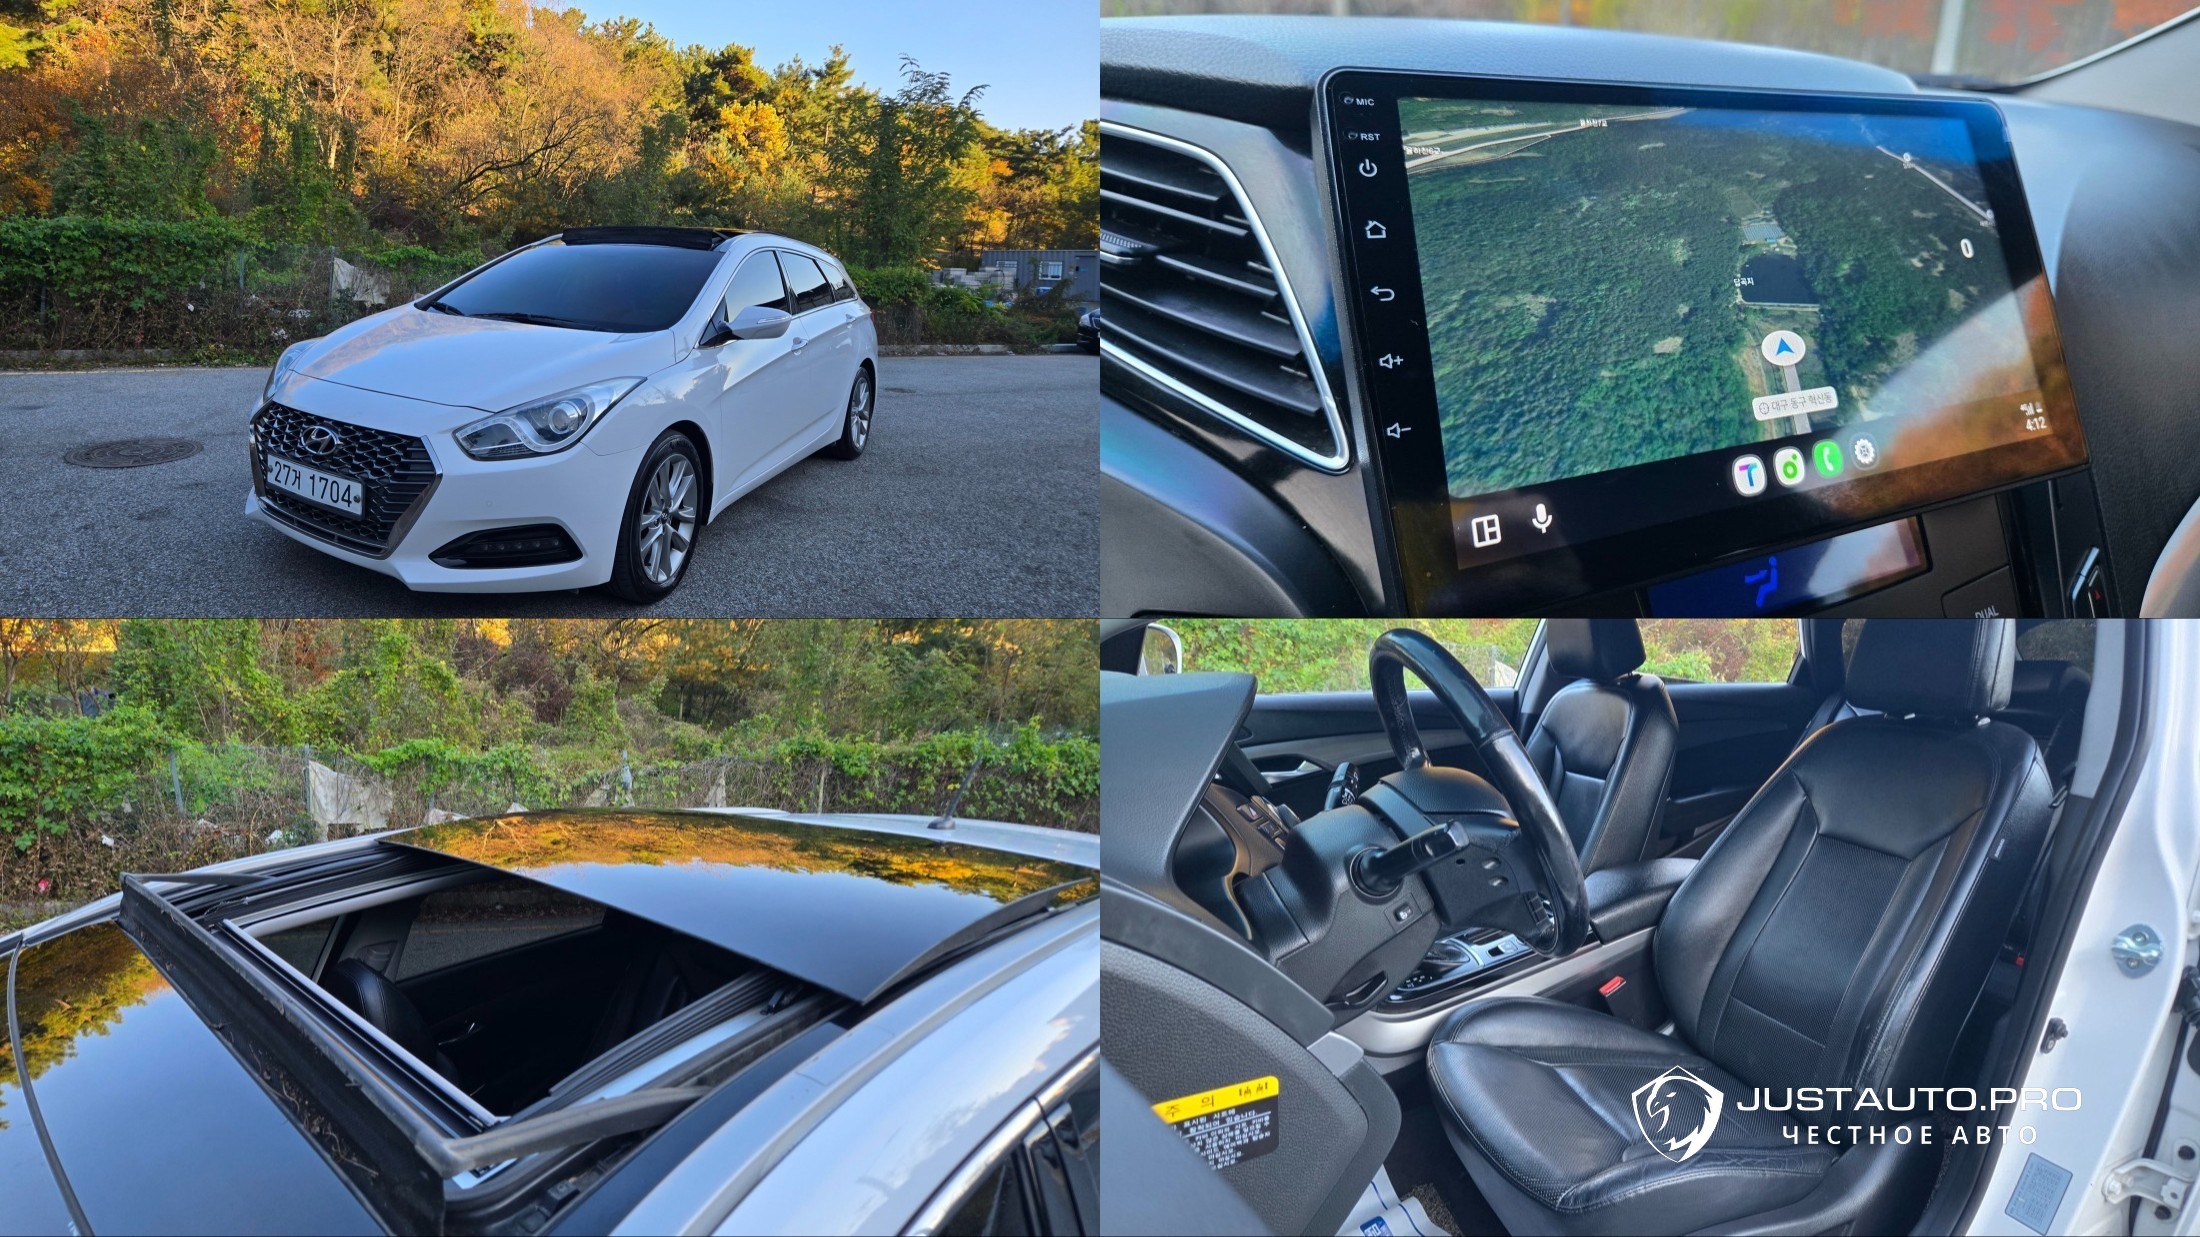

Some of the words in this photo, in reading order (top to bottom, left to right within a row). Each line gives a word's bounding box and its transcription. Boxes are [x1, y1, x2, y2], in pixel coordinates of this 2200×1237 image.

[1355, 98, 1375, 106] MIC
[1360, 133, 1380, 141] RST
[1771, 399, 1788, 411] 대구
[1790, 397, 1807, 409] 동구
[2026, 416, 2047, 431] 4:12
[274, 460, 301, 491] 27거
[310, 473, 352, 507] 1704
